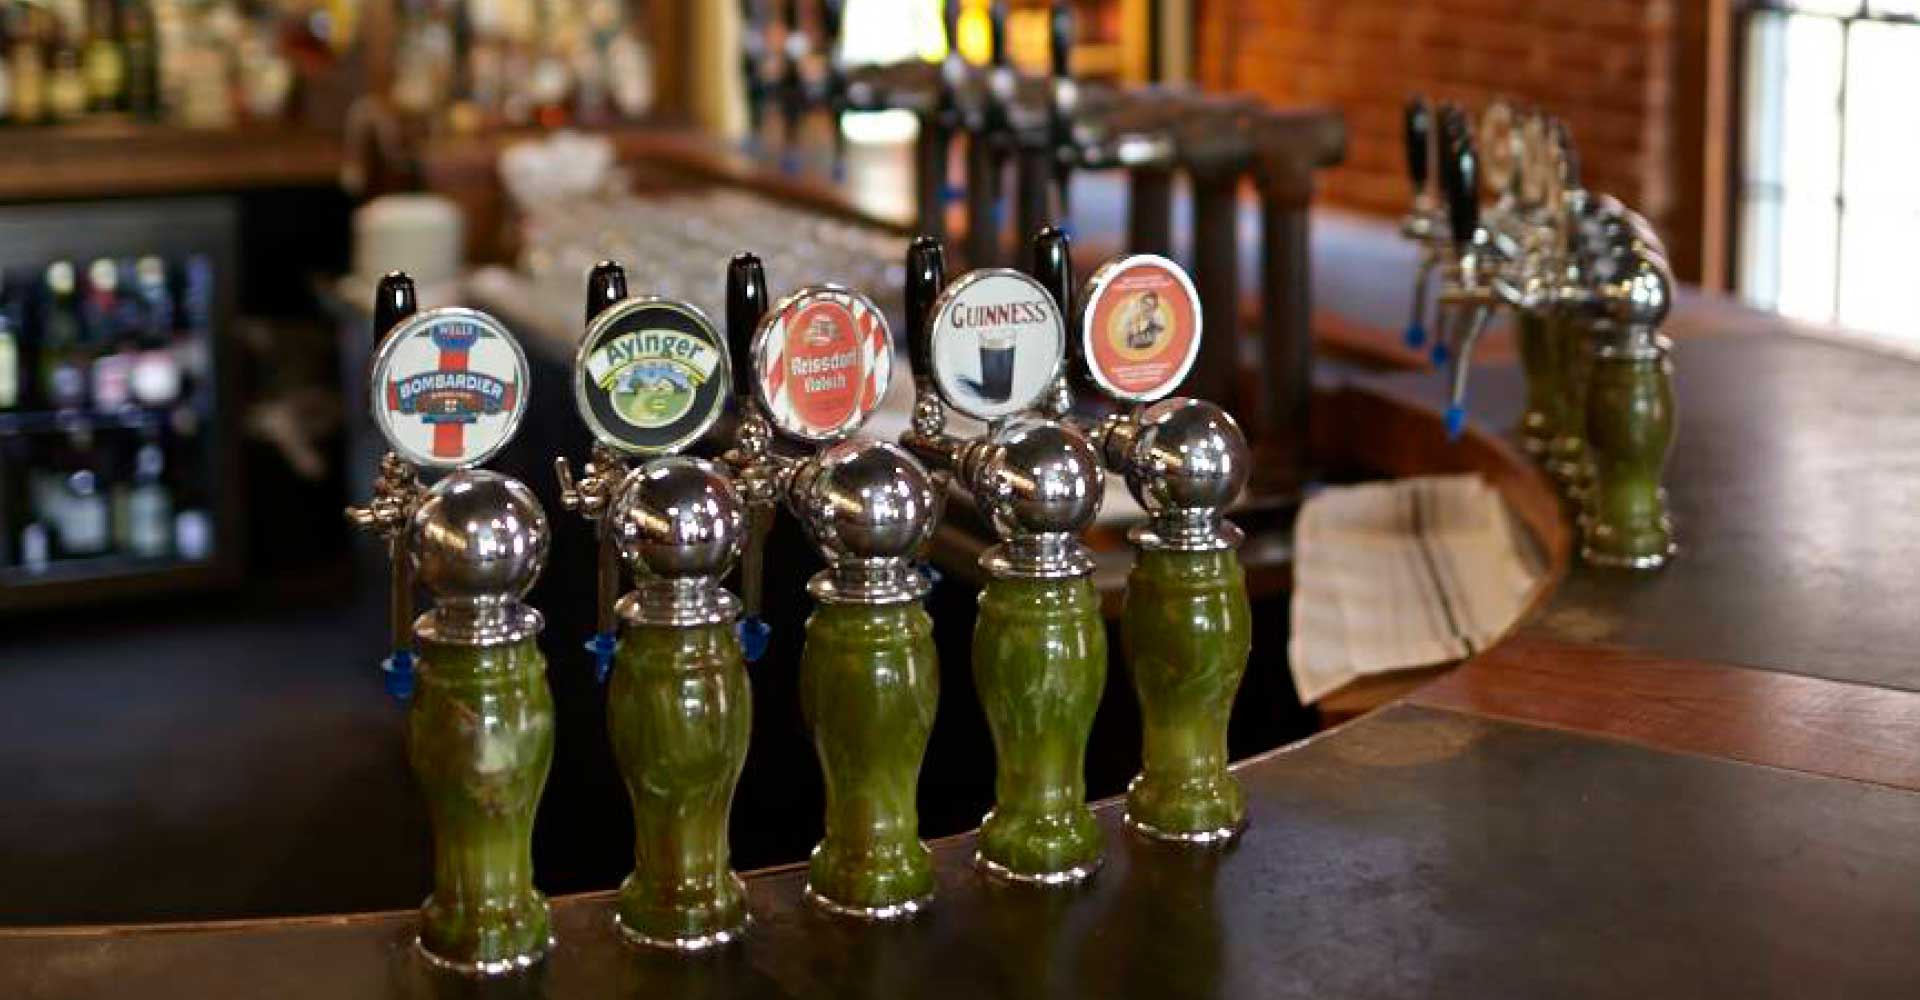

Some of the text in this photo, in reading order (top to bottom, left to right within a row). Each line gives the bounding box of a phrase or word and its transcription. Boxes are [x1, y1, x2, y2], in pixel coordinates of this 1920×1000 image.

[951, 301, 1047, 328] GUINNESS
[607, 331, 704, 363] Ayinger
[400, 374, 503, 400] BOMBARDIER
